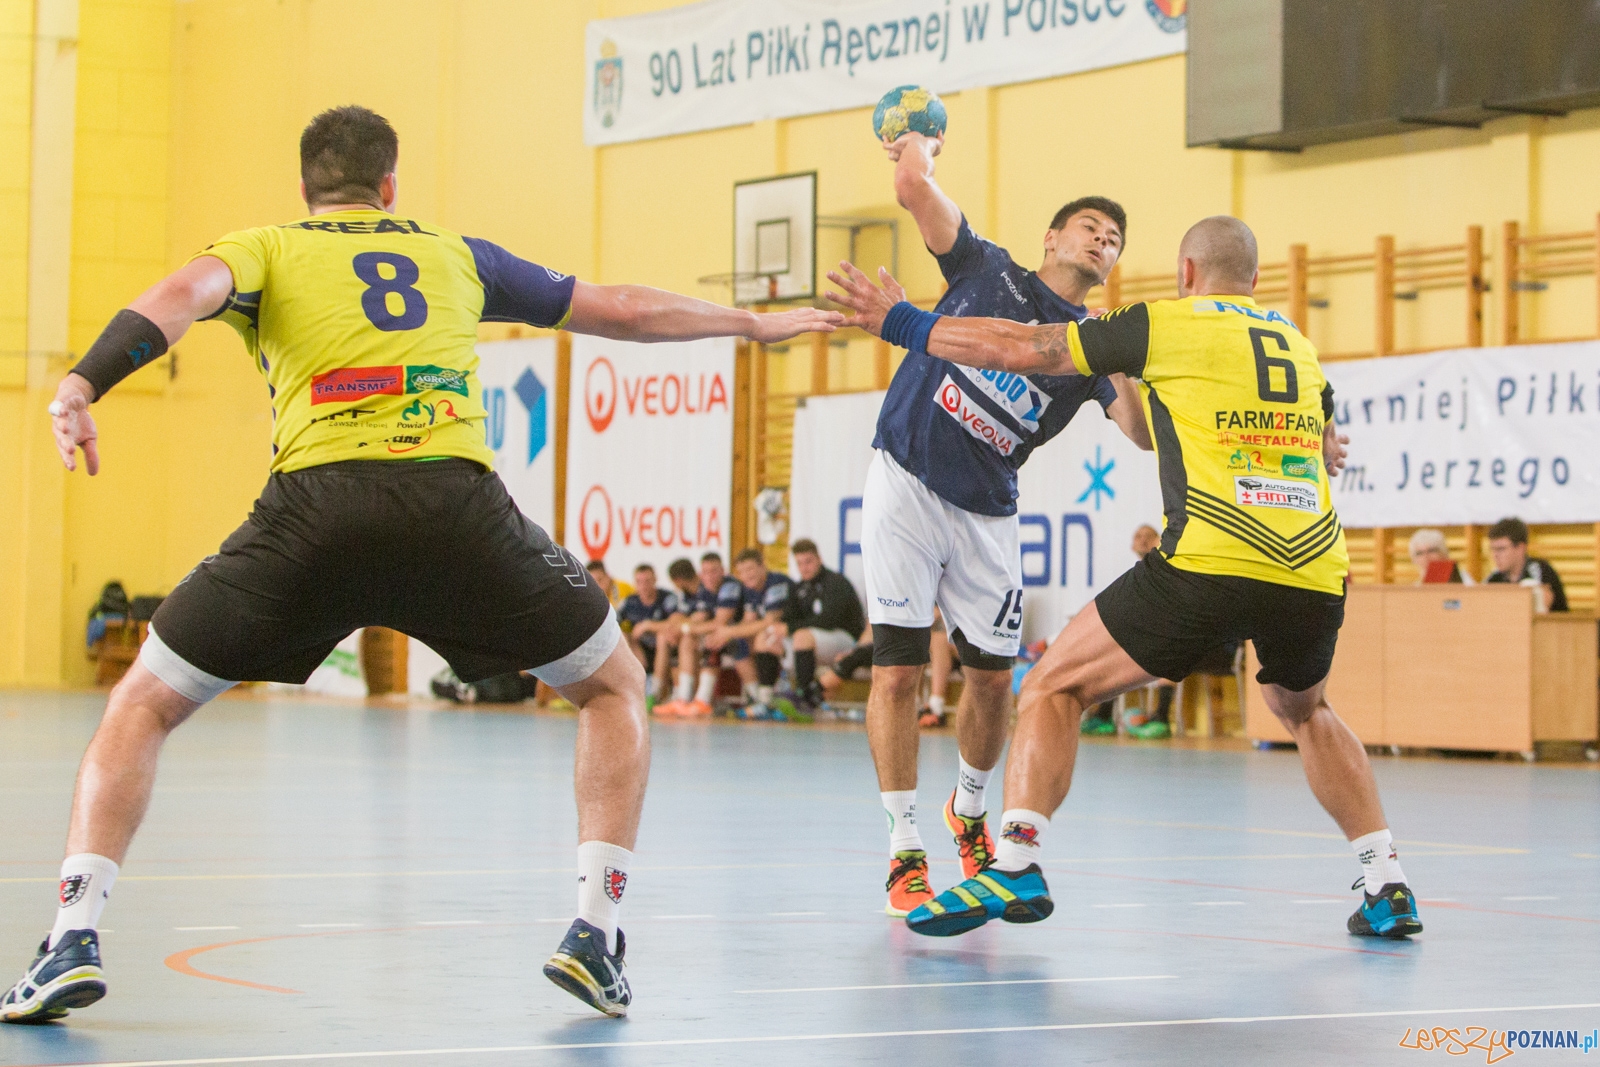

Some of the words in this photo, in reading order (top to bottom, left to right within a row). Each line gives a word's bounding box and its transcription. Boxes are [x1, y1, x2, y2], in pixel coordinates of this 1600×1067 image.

[648, 48, 683, 97] 90
[692, 38, 736, 89] Lat
[746, 23, 811, 80] Piłki
[820, 0, 951, 78] Ręcznej
[962, 2, 990, 43] w
[300, 219, 439, 237] REAL
[352, 252, 428, 332] 8
[1248, 327, 1299, 404] 6
[623, 372, 729, 416] VEOLIA
[1333, 377, 1468, 431] urniej
[396, 421, 426, 429] Powiat
[961, 405, 1012, 454] VEOLIA
[1240, 433, 1320, 451] METALPLAS
[1340, 464, 1375, 493] m.
[1397, 451, 1571, 499] Jerzego
[1256, 491, 1317, 510] AMPER
[617, 505, 723, 548] VEOLIA
[992, 588, 1023, 631] 15
